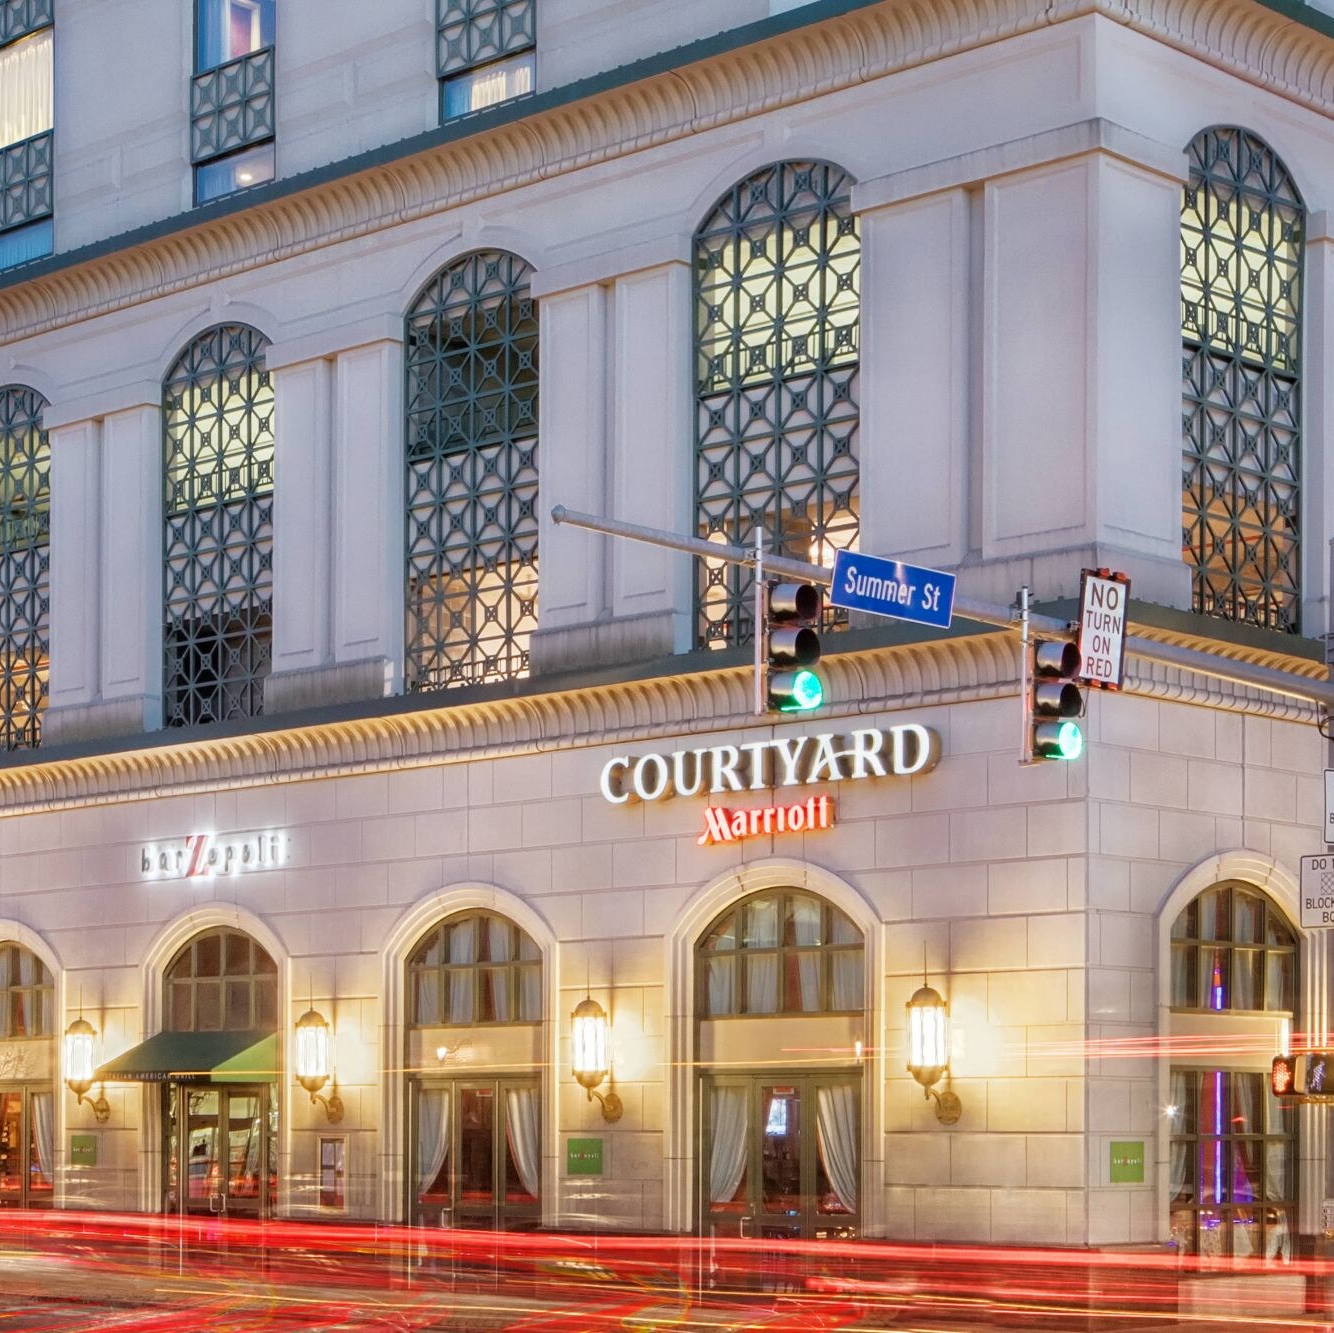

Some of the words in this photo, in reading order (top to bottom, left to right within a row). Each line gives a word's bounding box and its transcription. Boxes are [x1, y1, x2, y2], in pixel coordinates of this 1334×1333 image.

[844, 566, 916, 606] Summer
[921, 583, 941, 611] St
[1091, 582, 1119, 610] NO
[1086, 610, 1121, 635] TURN
[1092, 635, 1111, 656] ON
[1086, 656, 1112, 678] RED
[600, 723, 933, 804] COURTYARD
[697, 795, 832, 845] Marriott
[1311, 858, 1327, 871] DO
[135, 1072, 171, 1080] AMERICAN
